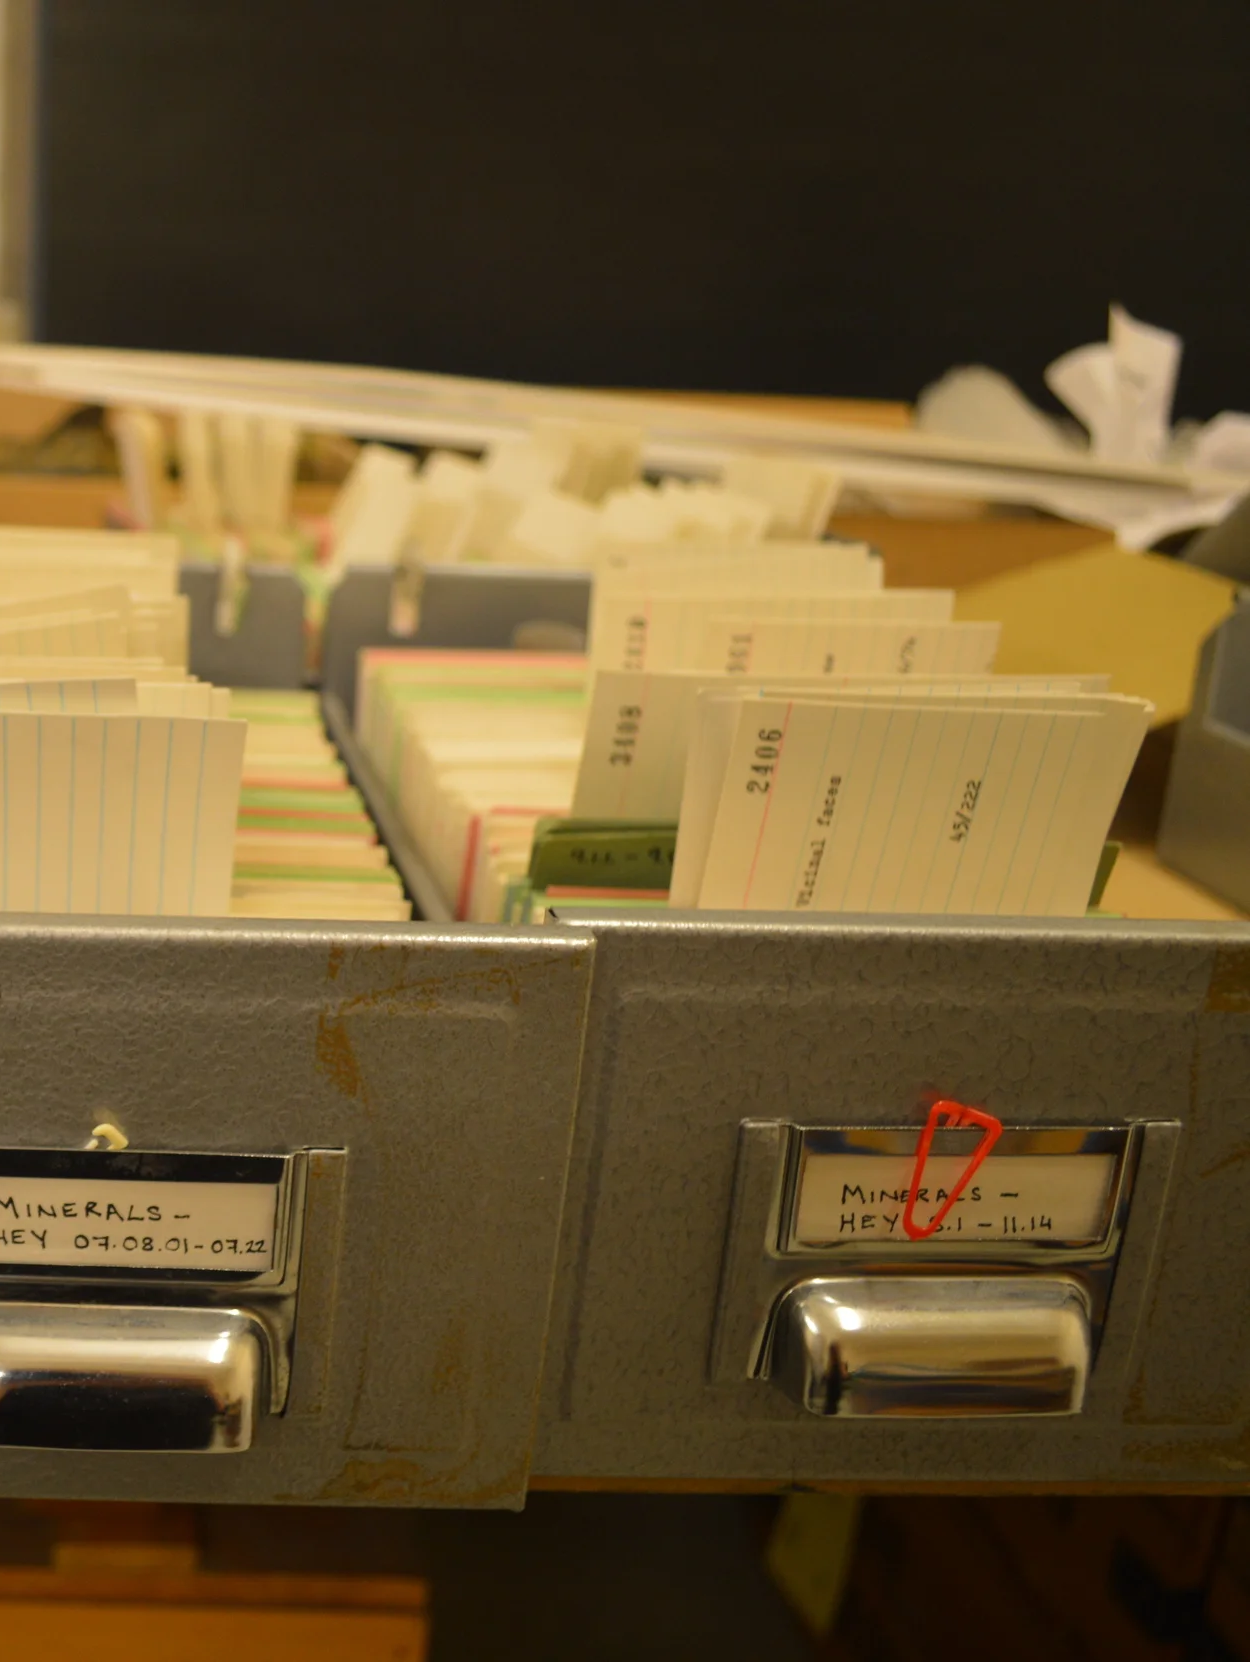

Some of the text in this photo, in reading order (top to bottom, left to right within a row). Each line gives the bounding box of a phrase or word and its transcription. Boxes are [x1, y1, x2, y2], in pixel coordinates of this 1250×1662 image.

[746, 728, 783, 795] 2406
[816, 775, 842, 827] faces
[949, 779, 982, 843] 45/222
[839, 1213, 900, 1233] HEY
[1002, 1214, 1053, 1235] 11.14
